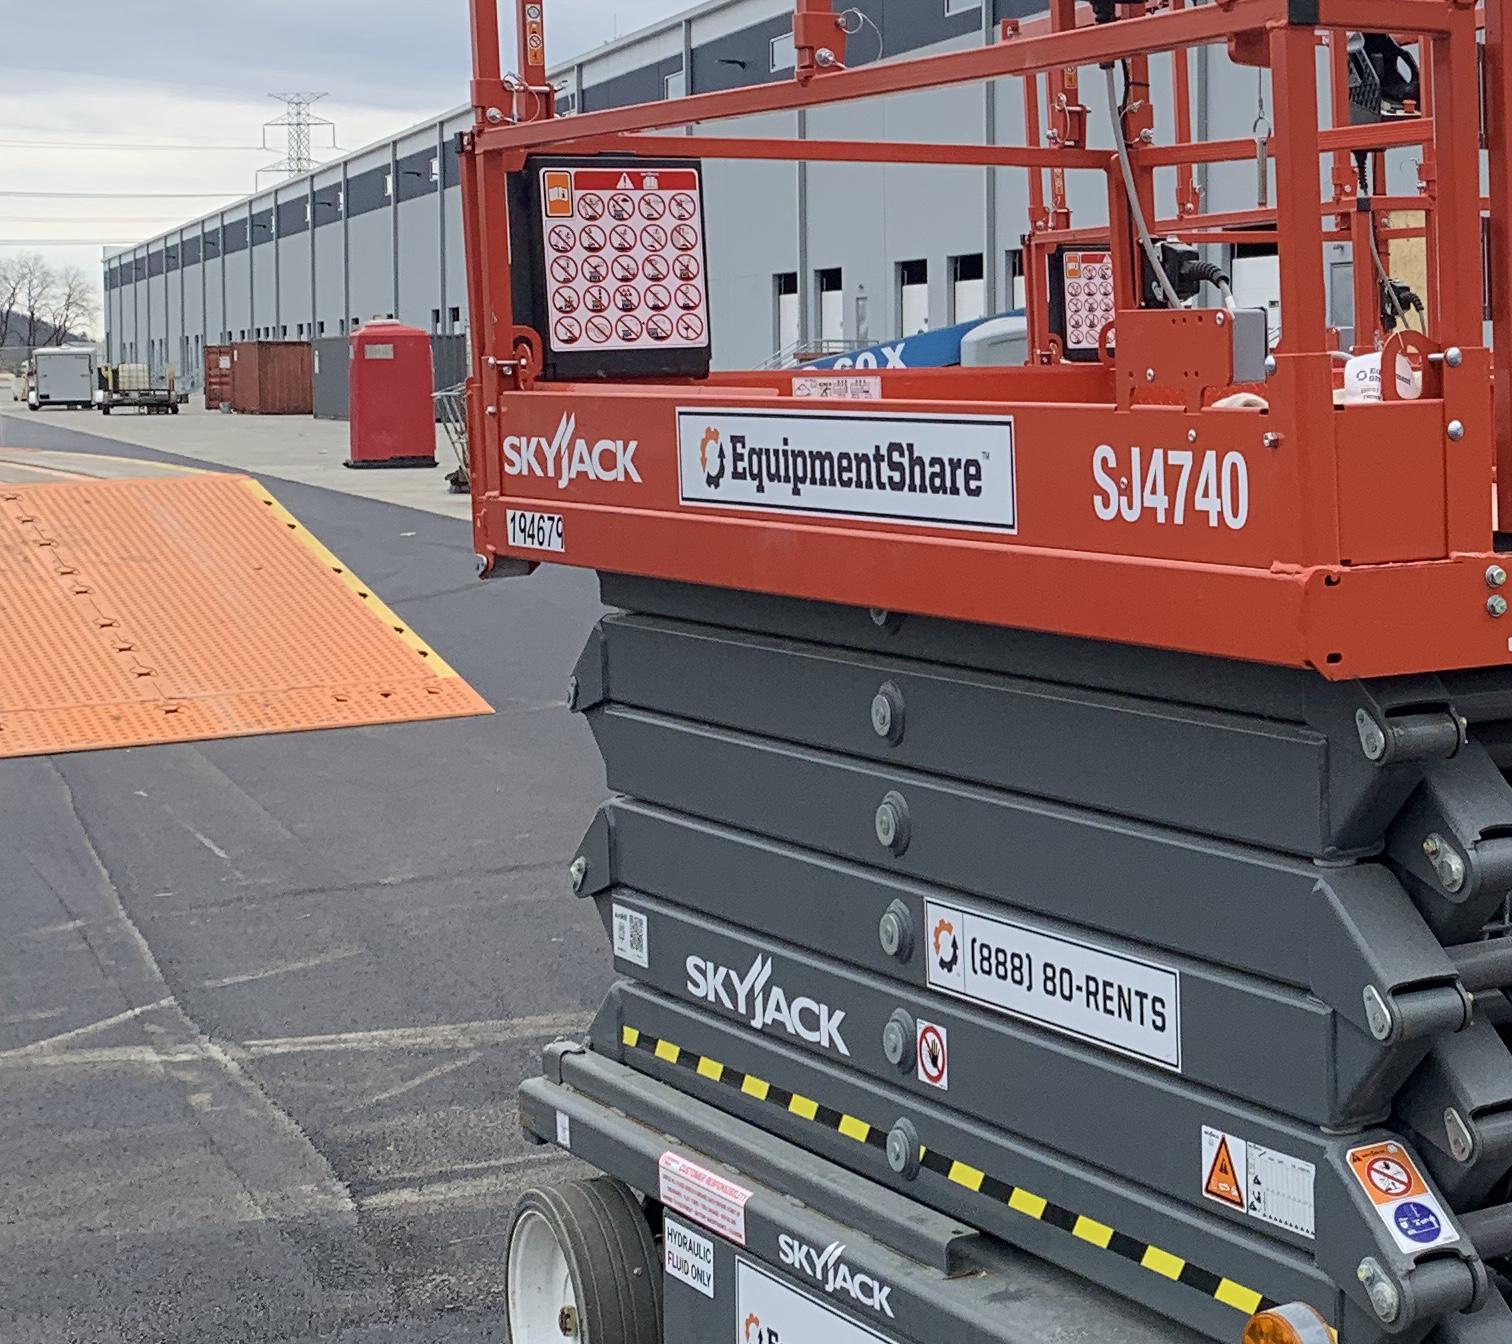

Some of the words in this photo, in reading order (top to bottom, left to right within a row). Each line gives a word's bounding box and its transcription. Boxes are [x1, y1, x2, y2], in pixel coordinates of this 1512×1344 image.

[503, 411, 642, 489] SKYJACK
[730, 435, 982, 497] EquipmentShare
[1093, 444, 1249, 530] SJ4740
[510, 511, 564, 549] 194679
[686, 953, 851, 1057] SKYJACK
[971, 937, 1033, 992] (888)
[1043, 962, 1167, 1033] 80-RENTS
[667, 1226, 712, 1264] HYDRAULIC
[667, 1250, 689, 1276] FLUID
[691, 1265, 712, 1288] ONLY
[778, 1234, 895, 1318] SKYJACK
